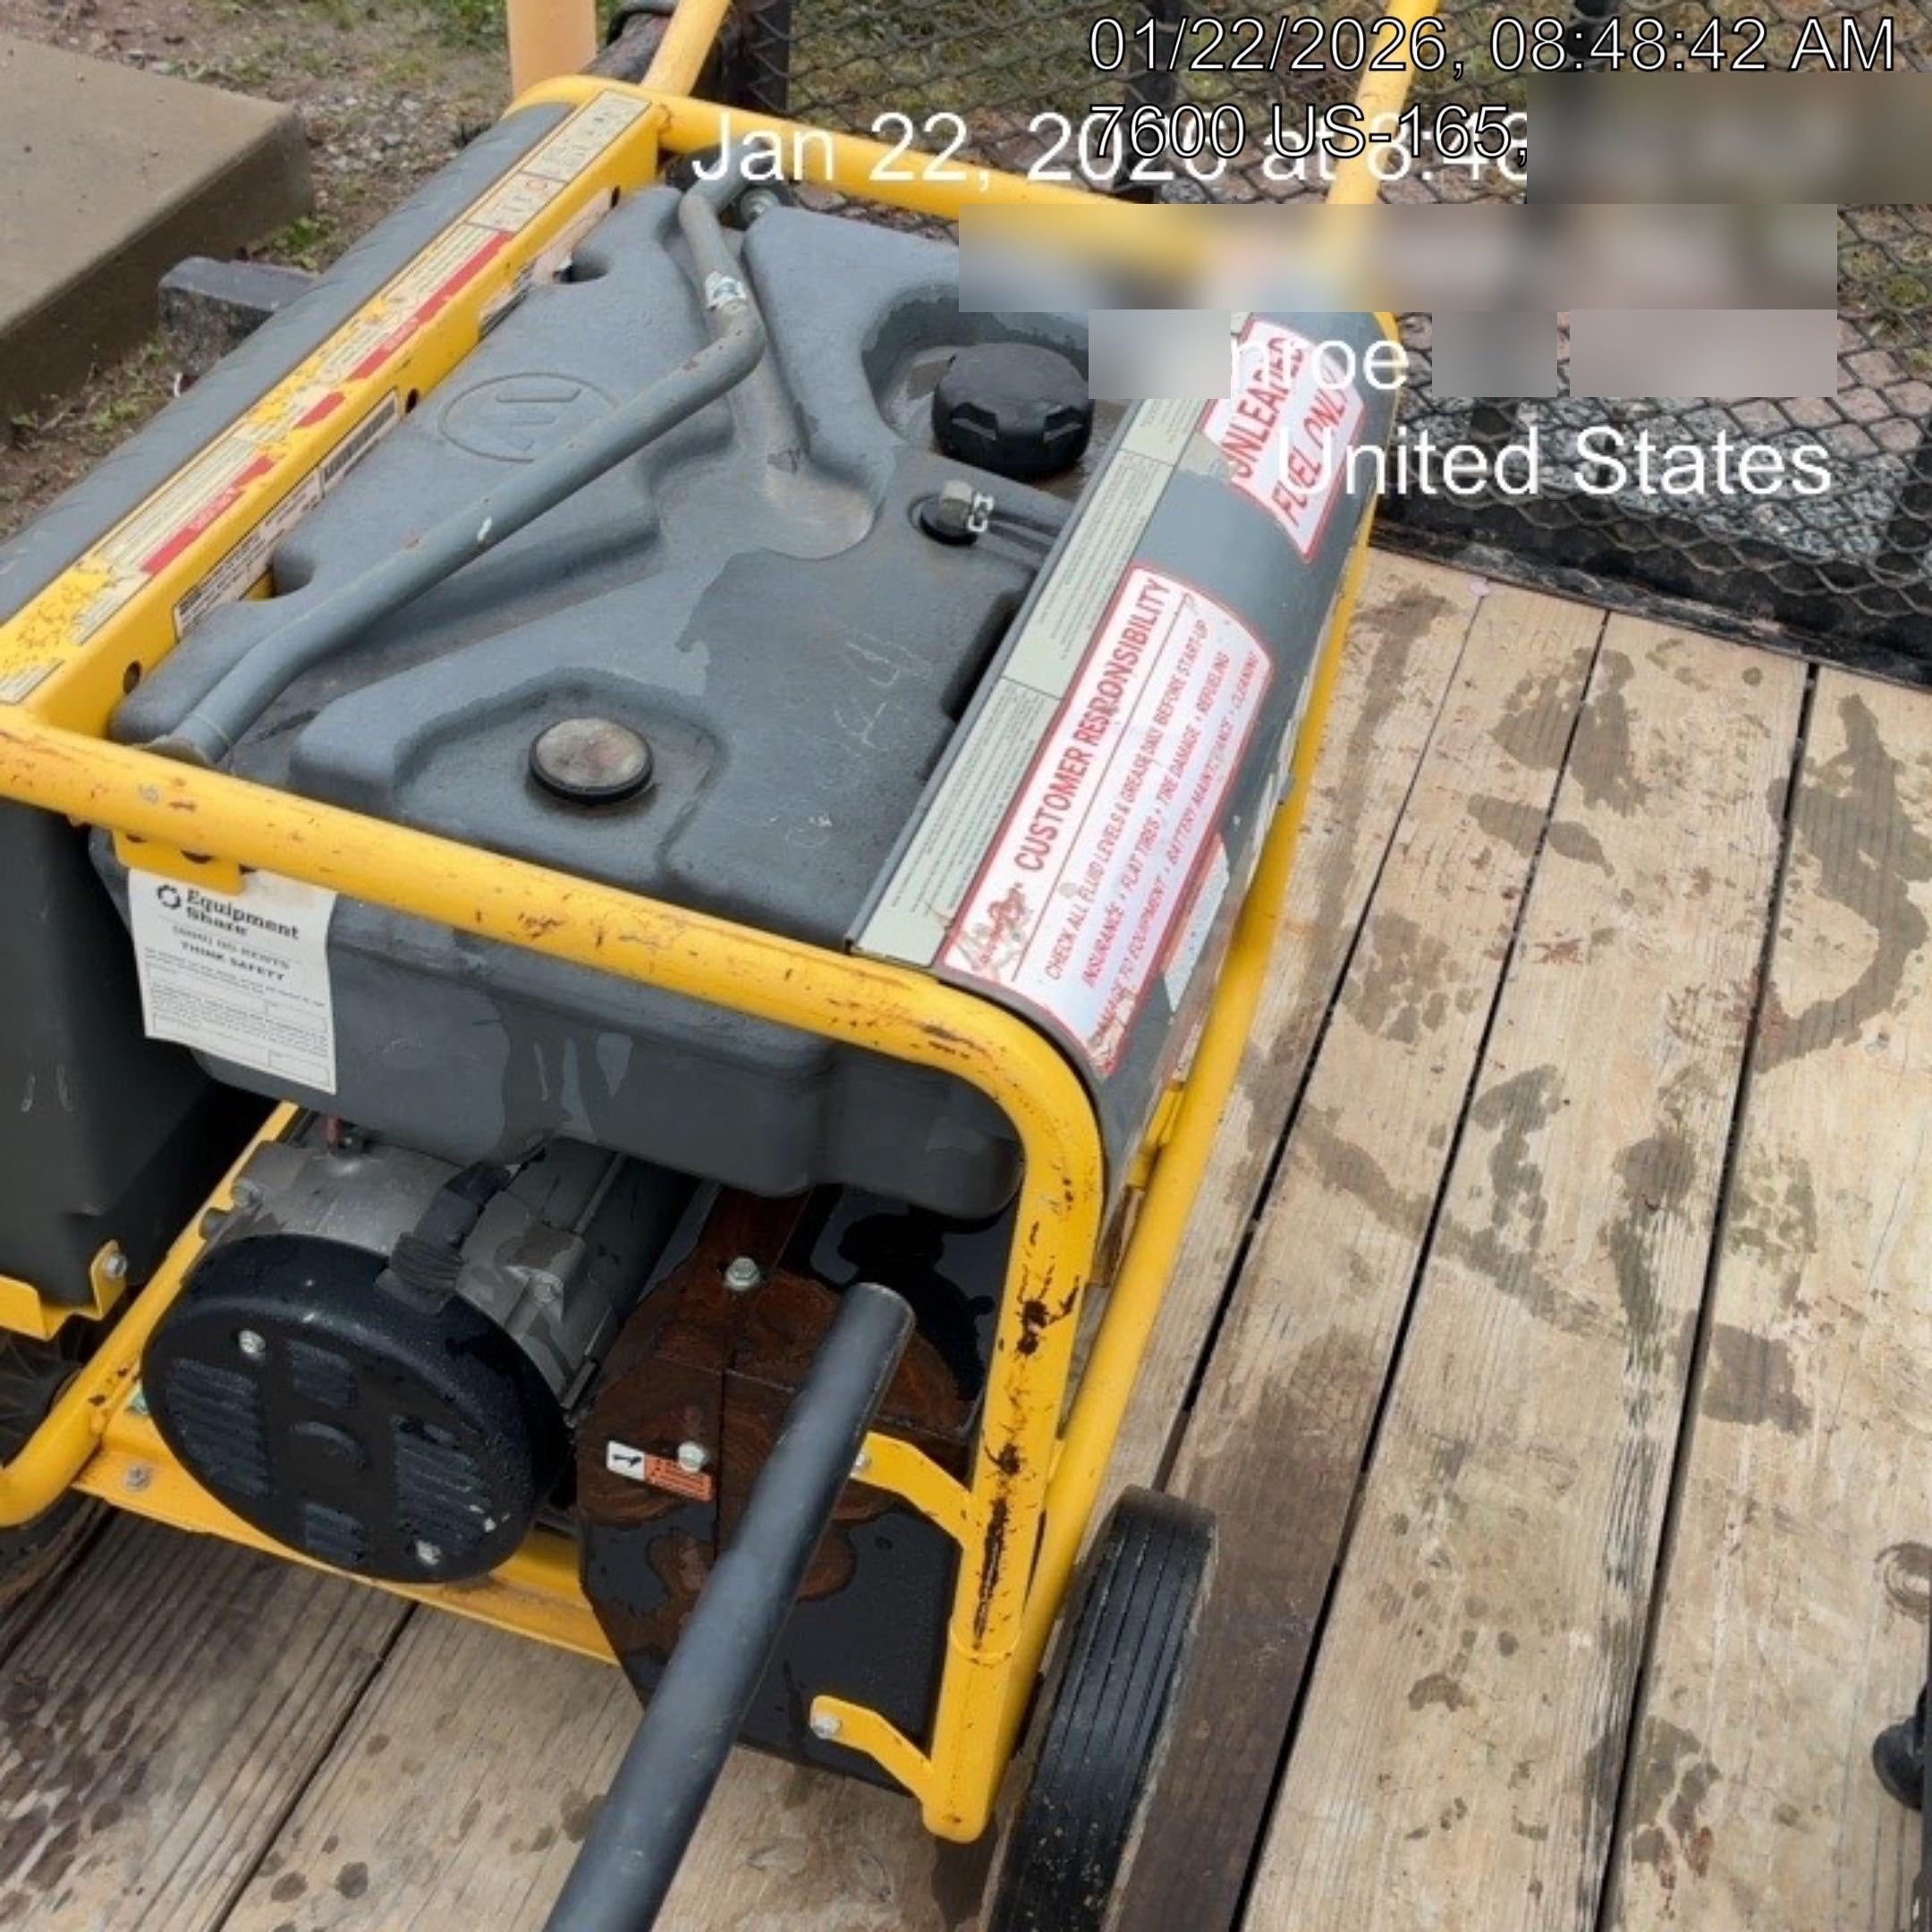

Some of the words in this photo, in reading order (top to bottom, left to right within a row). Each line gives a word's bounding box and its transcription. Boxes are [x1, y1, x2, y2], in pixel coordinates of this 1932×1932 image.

[1013, 745, 1093, 873] CUSTOMER
[1043, 927, 1076, 981] CHECK
[1067, 903, 1089, 931] ALL
[1097, 811, 1126, 862] LEVELS
[1153, 673, 1187, 726] BEFORE
[186, 886, 301, 940] Equipment
